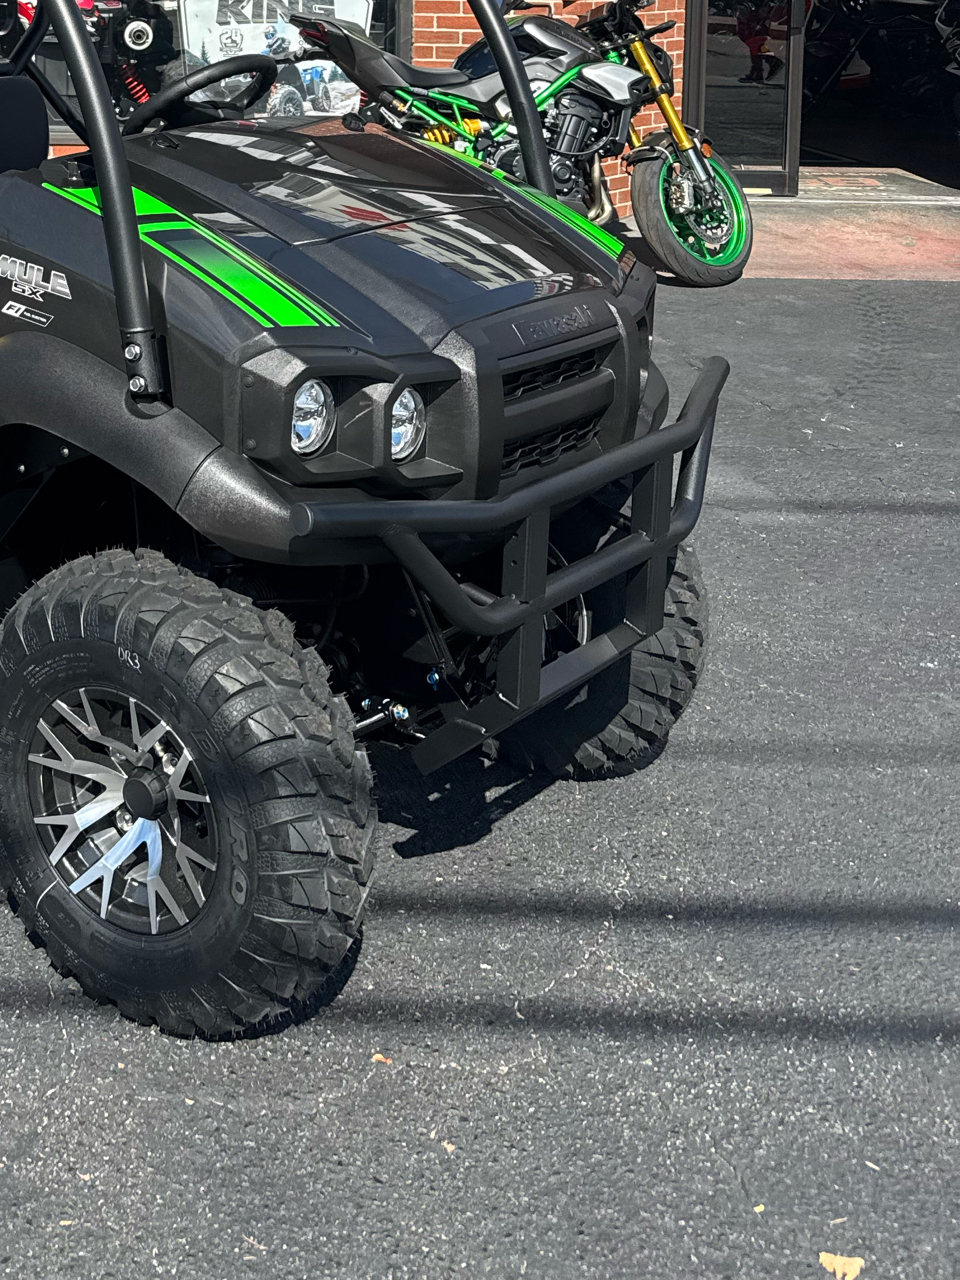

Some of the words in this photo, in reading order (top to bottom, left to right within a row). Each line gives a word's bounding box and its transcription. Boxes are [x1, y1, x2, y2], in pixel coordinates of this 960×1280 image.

[11, 280, 44, 302] SX
[5, 304, 22, 314] FI
[512, 304, 595, 346] Kawasaki
